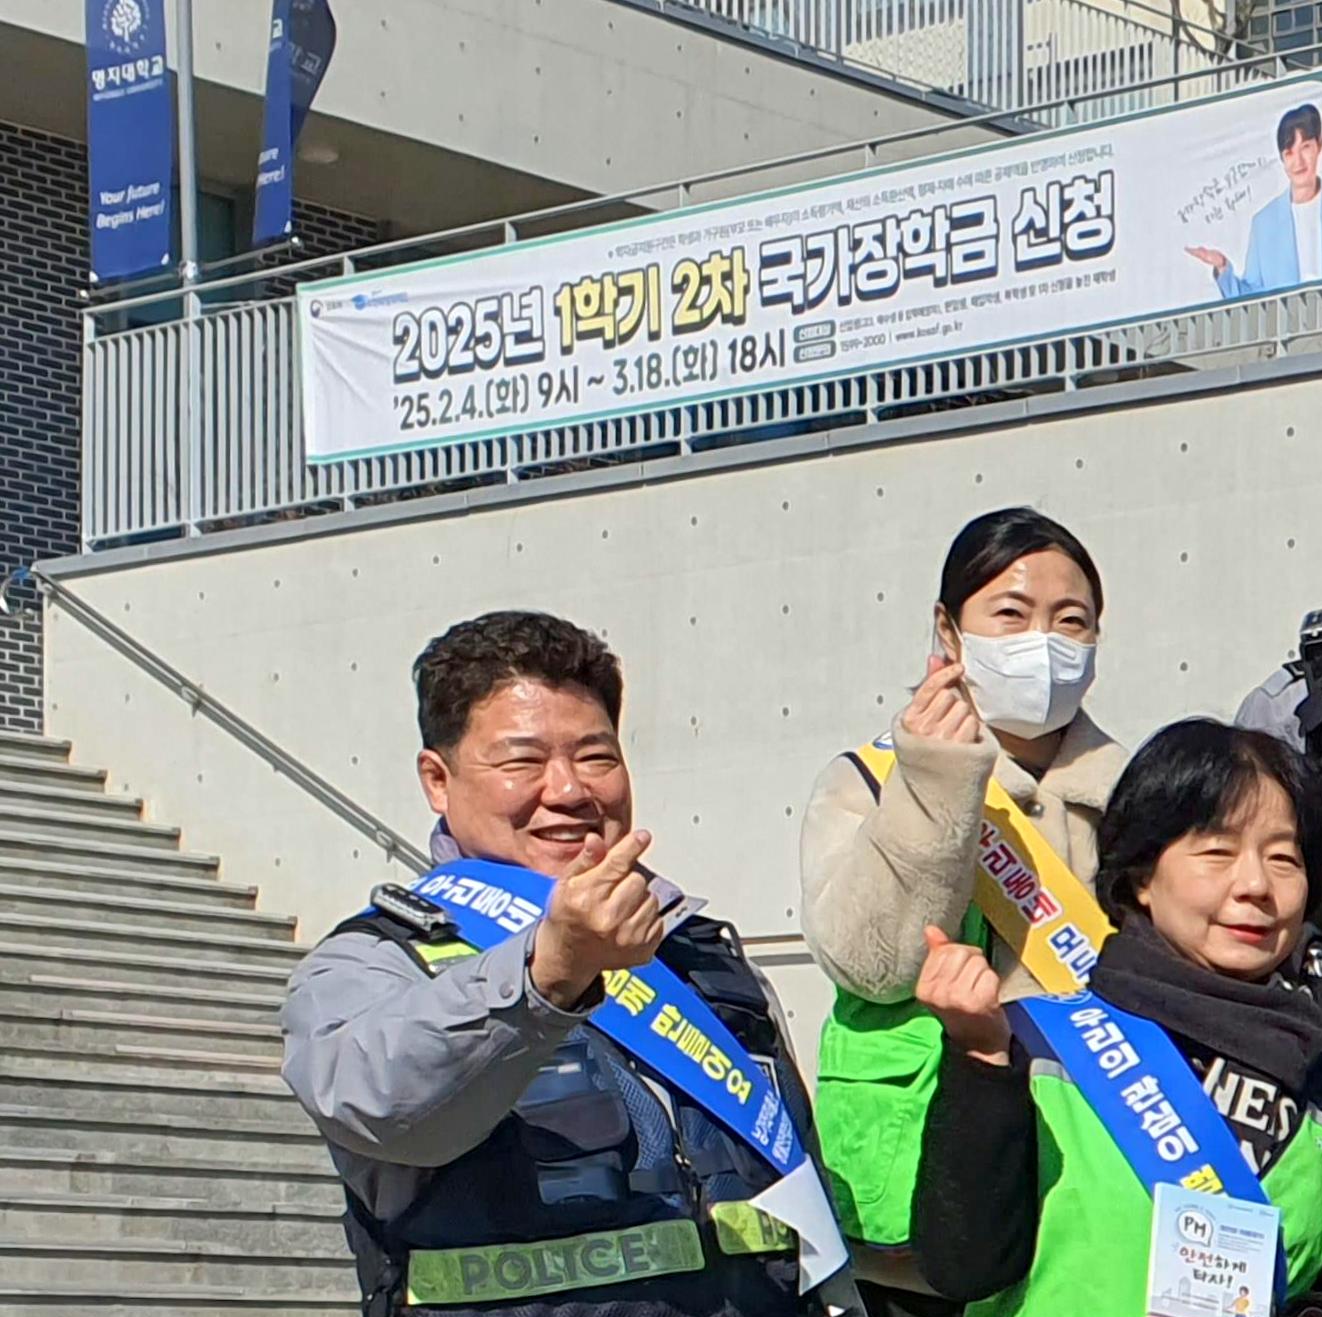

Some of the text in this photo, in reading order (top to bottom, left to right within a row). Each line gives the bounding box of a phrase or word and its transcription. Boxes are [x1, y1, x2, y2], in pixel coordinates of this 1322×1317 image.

[92, 55, 163, 90] 명지대학교
[97, 206, 134, 229] Begins
[100, 182, 160, 205] Your future
[393, 286, 545, 384] 2025년
[554, 263, 662, 355] 1학기
[672, 245, 748, 334] 2차
[759, 195, 998, 315] 국가장학금
[1013, 170, 1115, 271] 신청
[538, 365, 578, 408] 9시
[729, 328, 785, 375] 18시
[650, 1002, 752, 1105] 만들어요
[1069, 1007, 1199, 1162] 우리의 관심이
[1184, 1216, 1207, 1238] PM
[460, 1233, 646, 1296] POLICE
[1179, 1246, 1247, 1273] 안전하게
